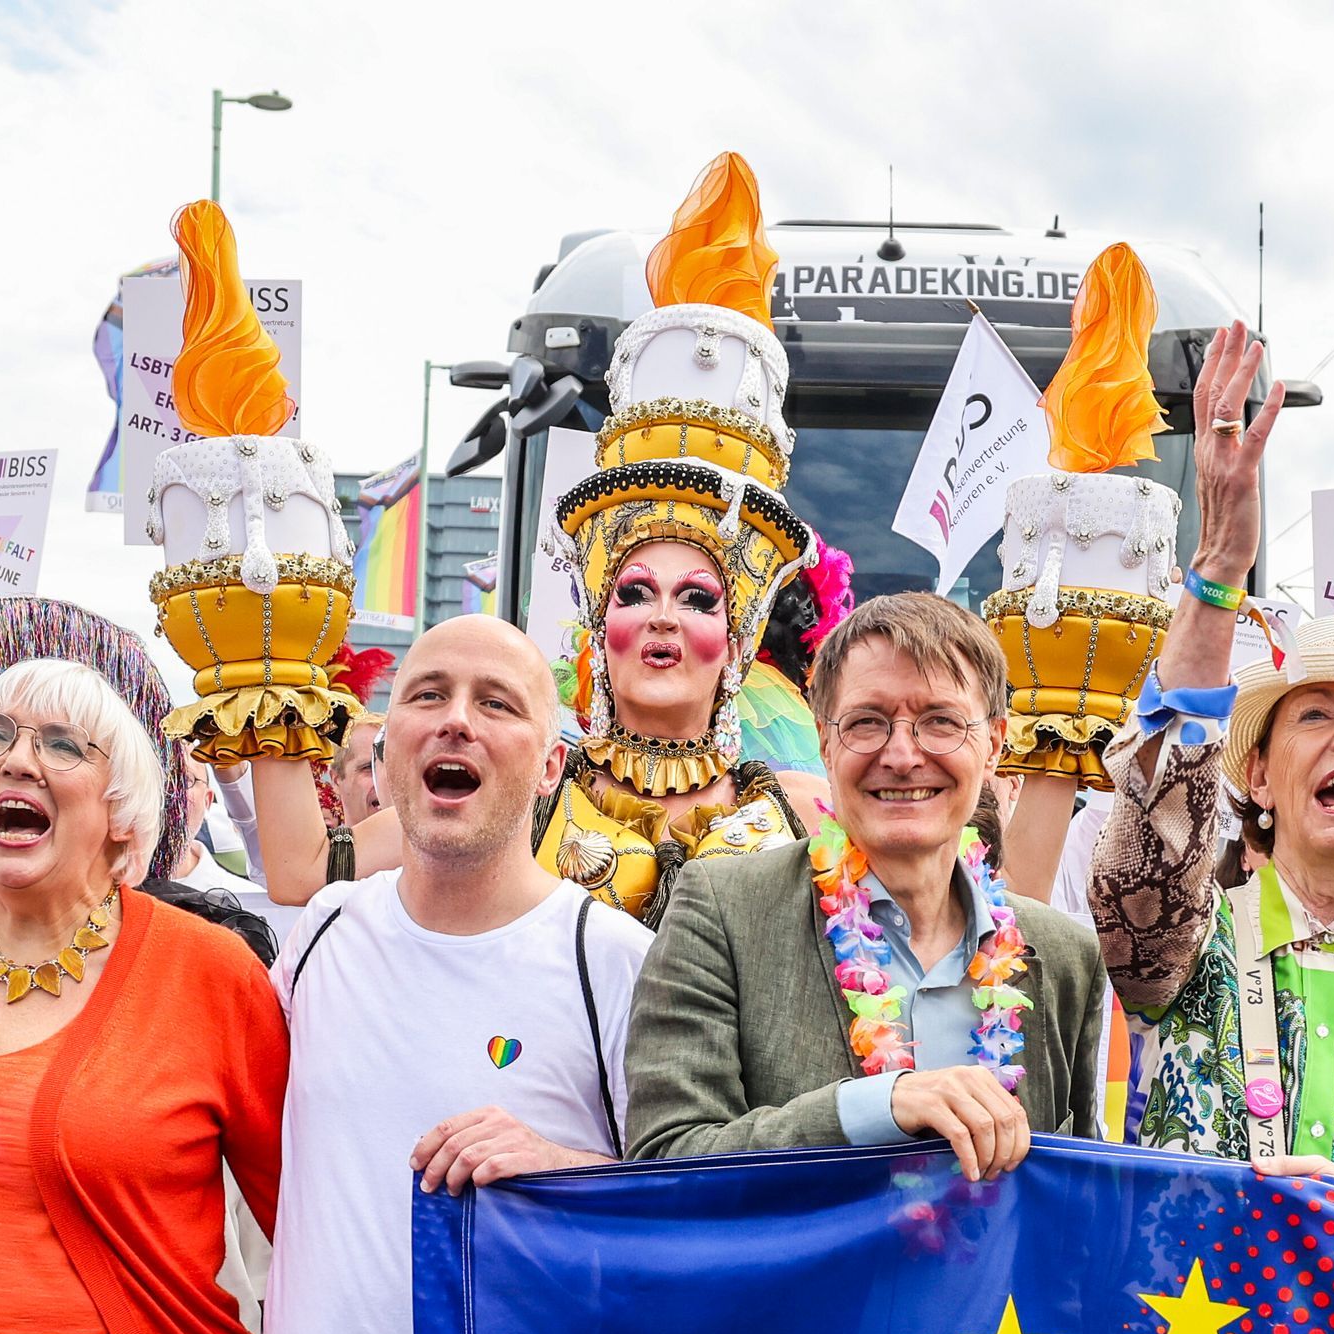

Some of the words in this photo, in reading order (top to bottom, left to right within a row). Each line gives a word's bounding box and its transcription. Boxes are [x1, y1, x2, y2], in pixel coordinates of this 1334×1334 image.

[793, 266, 1080, 300] PARADEKING.DE
[127, 413, 167, 438] ART.
[170, 427, 182, 443] 3
[8, 455, 48, 478] BISS
[1202, 585, 1225, 599] 2024
